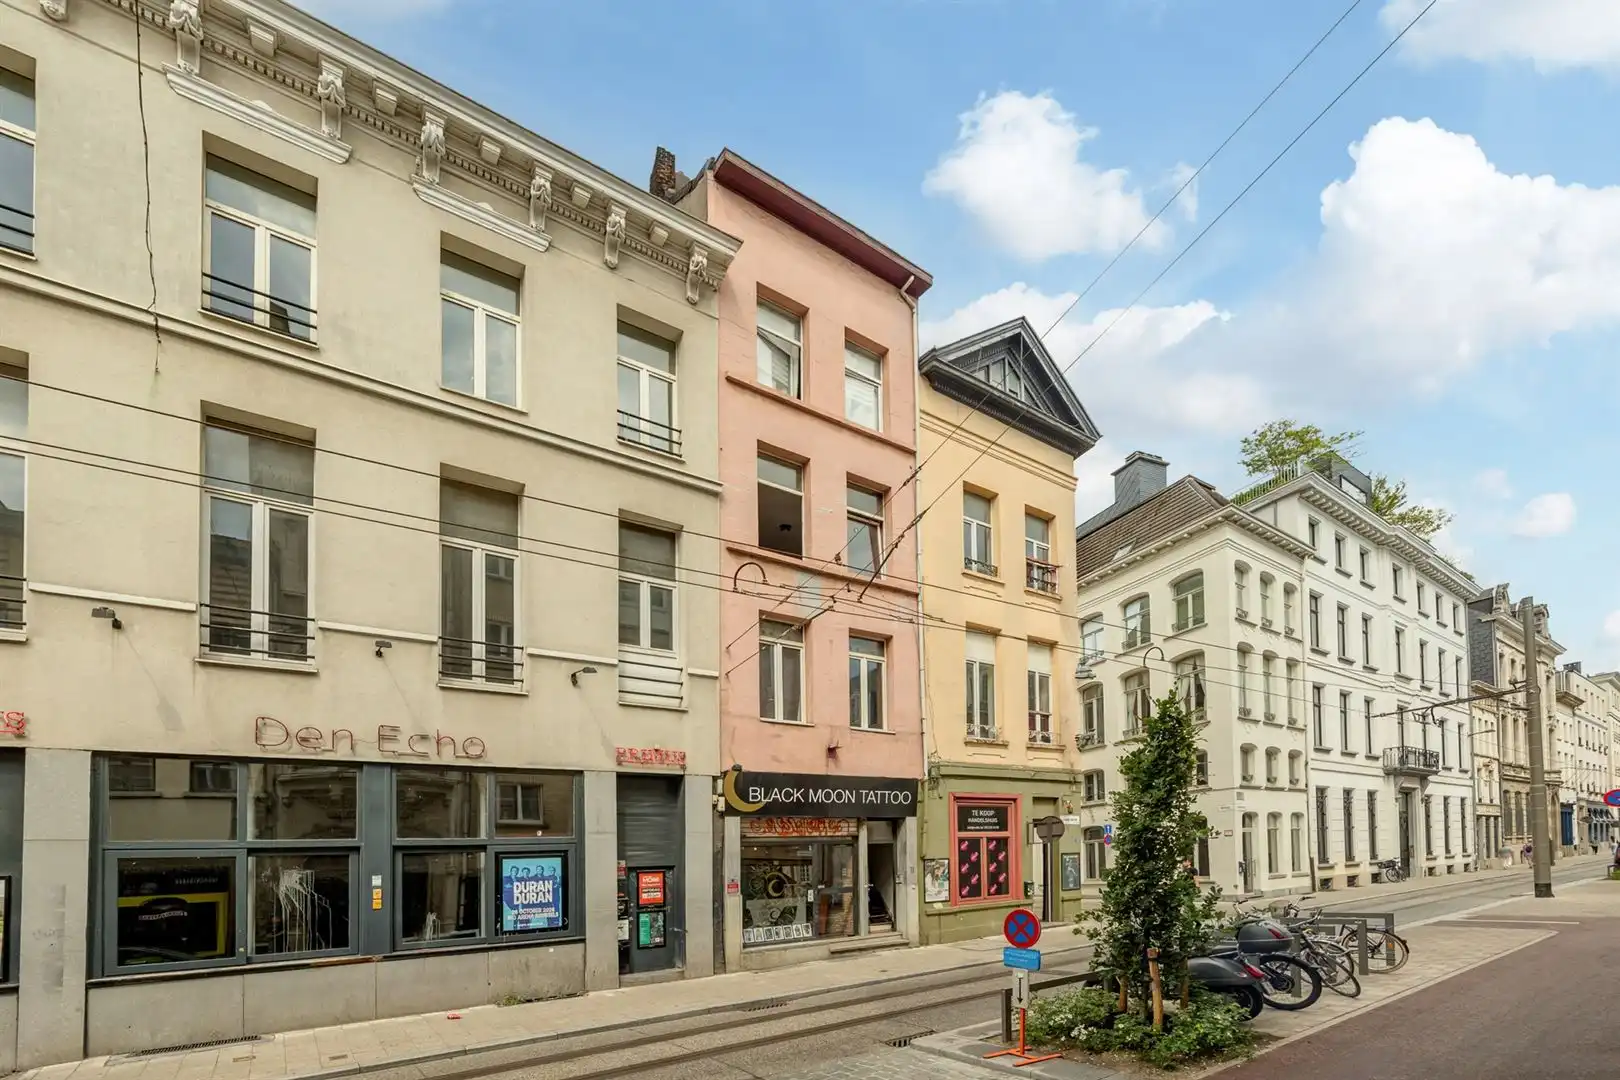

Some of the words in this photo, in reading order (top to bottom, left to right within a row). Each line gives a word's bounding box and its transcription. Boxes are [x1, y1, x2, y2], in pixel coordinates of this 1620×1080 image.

[255, 716, 354, 752] Den
[378, 724, 486, 759] Echo
[749, 786, 805, 803] BLACK
[808, 788, 856, 804] MOON
[859, 789, 912, 805] TATTOO
[513, 881, 553, 893] DURAN
[513, 892, 553, 905] DURAN
